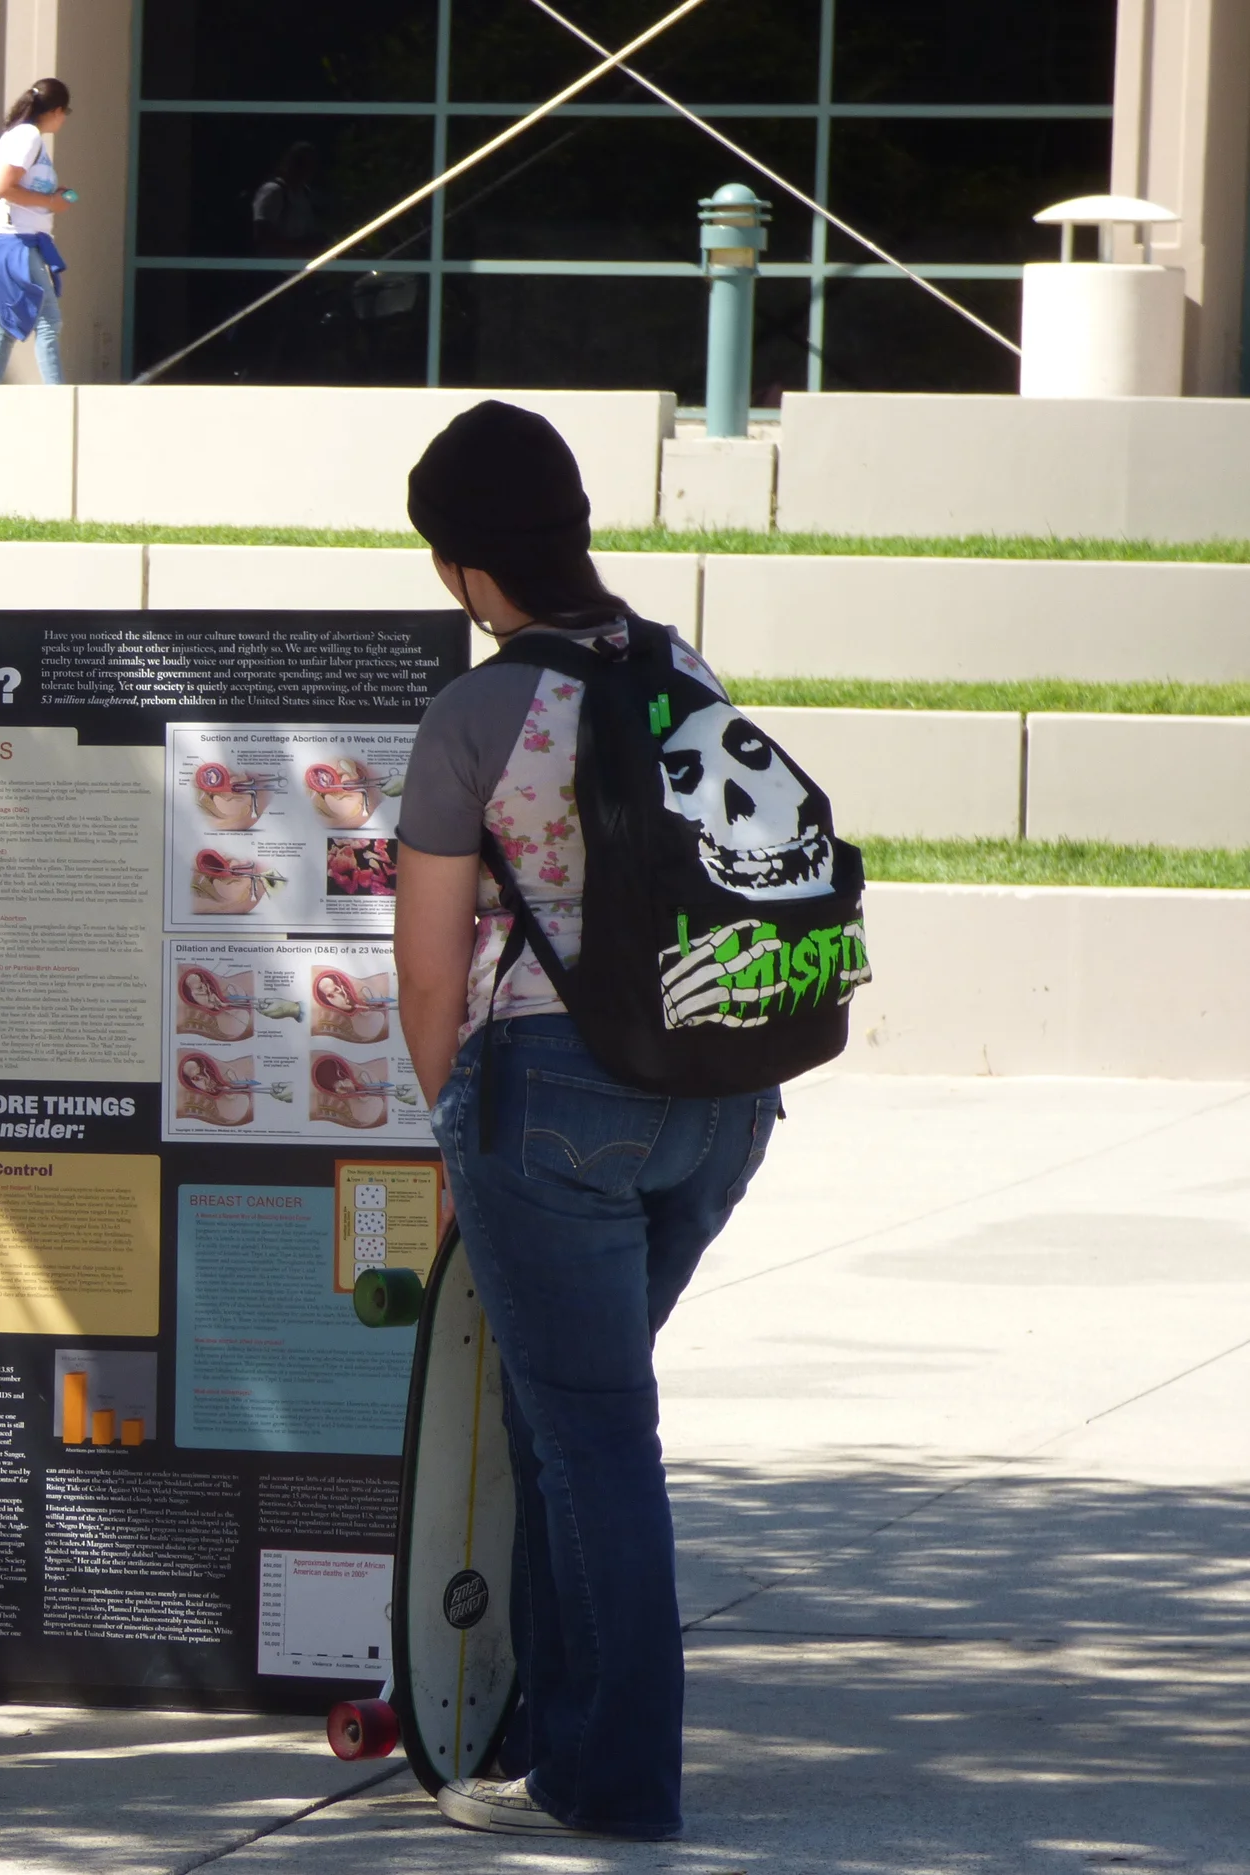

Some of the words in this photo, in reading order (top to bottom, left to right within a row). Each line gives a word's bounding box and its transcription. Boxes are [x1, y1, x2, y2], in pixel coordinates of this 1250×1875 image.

[44, 630, 68, 640] Have
[70, 634, 87, 643] you
[90, 630, 123, 640] noticed
[125, 631, 140, 641] the
[142, 631, 172, 641] silence
[175, 631, 184, 641] in
[204, 631, 236, 641] culture
[238, 631, 270, 641] toward
[272, 631, 287, 641] the
[289, 631, 319, 643] reality
[320, 631, 331, 641] of
[332, 631, 376, 641] abortion?
[377, 631, 411, 643] Society
[41, 643, 70, 655] speaks
[72, 646, 84, 655] up
[87, 643, 115, 655] loudly
[117, 643, 143, 653] about
[145, 643, 169, 653] other
[172, 644, 216, 655] injustices,
[218, 643, 236, 653] and
[238, 643, 268, 655] rightly
[285, 644, 301, 654] We
[320, 644, 352, 656] willing
[353, 645, 364, 654] to
[366, 644, 387, 656] fight
[389, 644, 422, 656] against
[41, 655, 72, 668] cruelty
[74, 655, 106, 665] toward
[108, 655, 146, 667] animals;
[162, 655, 191, 668] loudly
[193, 656, 216, 666] voice
[236, 656, 285, 668] opposition
[288, 658, 297, 666] to
[299, 656, 327, 666] unfair
[329, 656, 353, 666] labor
[355, 657, 397, 669] practices;
[414, 656, 440, 666] stand
[41, 668, 50, 678] in
[52, 669, 84, 680] protest
[86, 668, 98, 678] of
[98, 668, 155, 681] irresponsible
[157, 670, 211, 681] government
[213, 668, 231, 678] and
[233, 670, 276, 681] corporate
[279, 669, 323, 682] spending;
[325, 669, 342, 679] and
[359, 673, 374, 682] say
[391, 669, 409, 679] will
[410, 671, 427, 679] not
[41, 680, 75, 691] tolerate
[77, 680, 116, 693] bullying.
[118, 681, 134, 691] Yet
[153, 681, 185, 693] society
[187, 681, 194, 691] is
[196, 681, 228, 693] quietly
[230, 681, 276, 693] accepting,
[301, 683, 349, 695] approving,
[351, 682, 362, 692] of
[364, 682, 379, 692] the
[406, 682, 428, 692] than
[200, 734, 231, 742] Suction
[251, 735, 290, 744] Curettage
[292, 735, 328, 743] Abortion
[314, 946, 338, 954] (D&E)
[340, 946, 349, 954] of
[44, 1096, 136, 1116] THINGS
[190, 1195, 242, 1207] BREAST
[246, 1196, 302, 1208] CANCER
